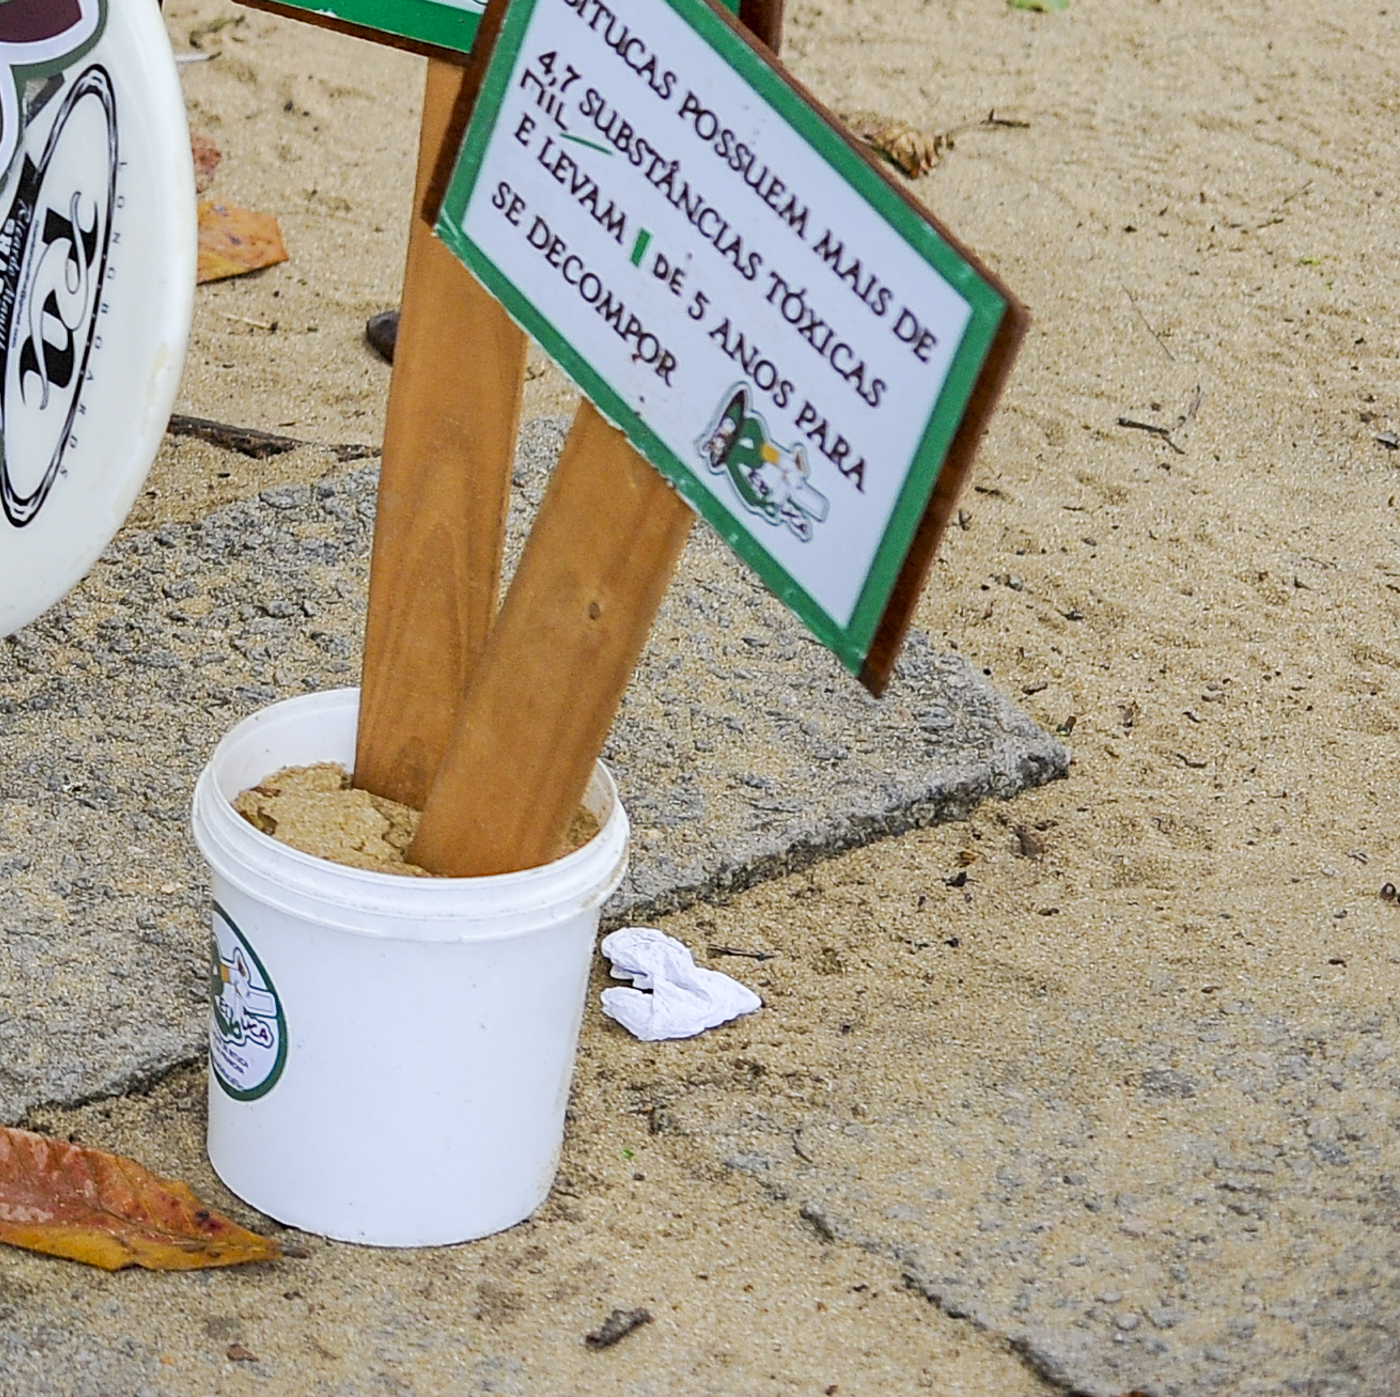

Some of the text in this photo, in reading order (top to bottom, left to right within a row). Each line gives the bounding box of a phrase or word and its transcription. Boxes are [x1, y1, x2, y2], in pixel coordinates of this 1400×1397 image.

[492, 181, 678, 388] SE DECOMPOR
[514, 112, 536, 146] E
[537, 136, 626, 245] LEVAM
[653, 253, 686, 296] DE
[687, 290, 708, 321] 5
[708, 318, 795, 410] ANOS
[794, 401, 868, 493] PARA
[538, 51, 887, 408] 4,7 SUBSTÂNCIAS TÓXICAS
[679, 88, 810, 241] POSSUEM
[812, 227, 894, 318] MAIS
[892, 309, 939, 363] DE
